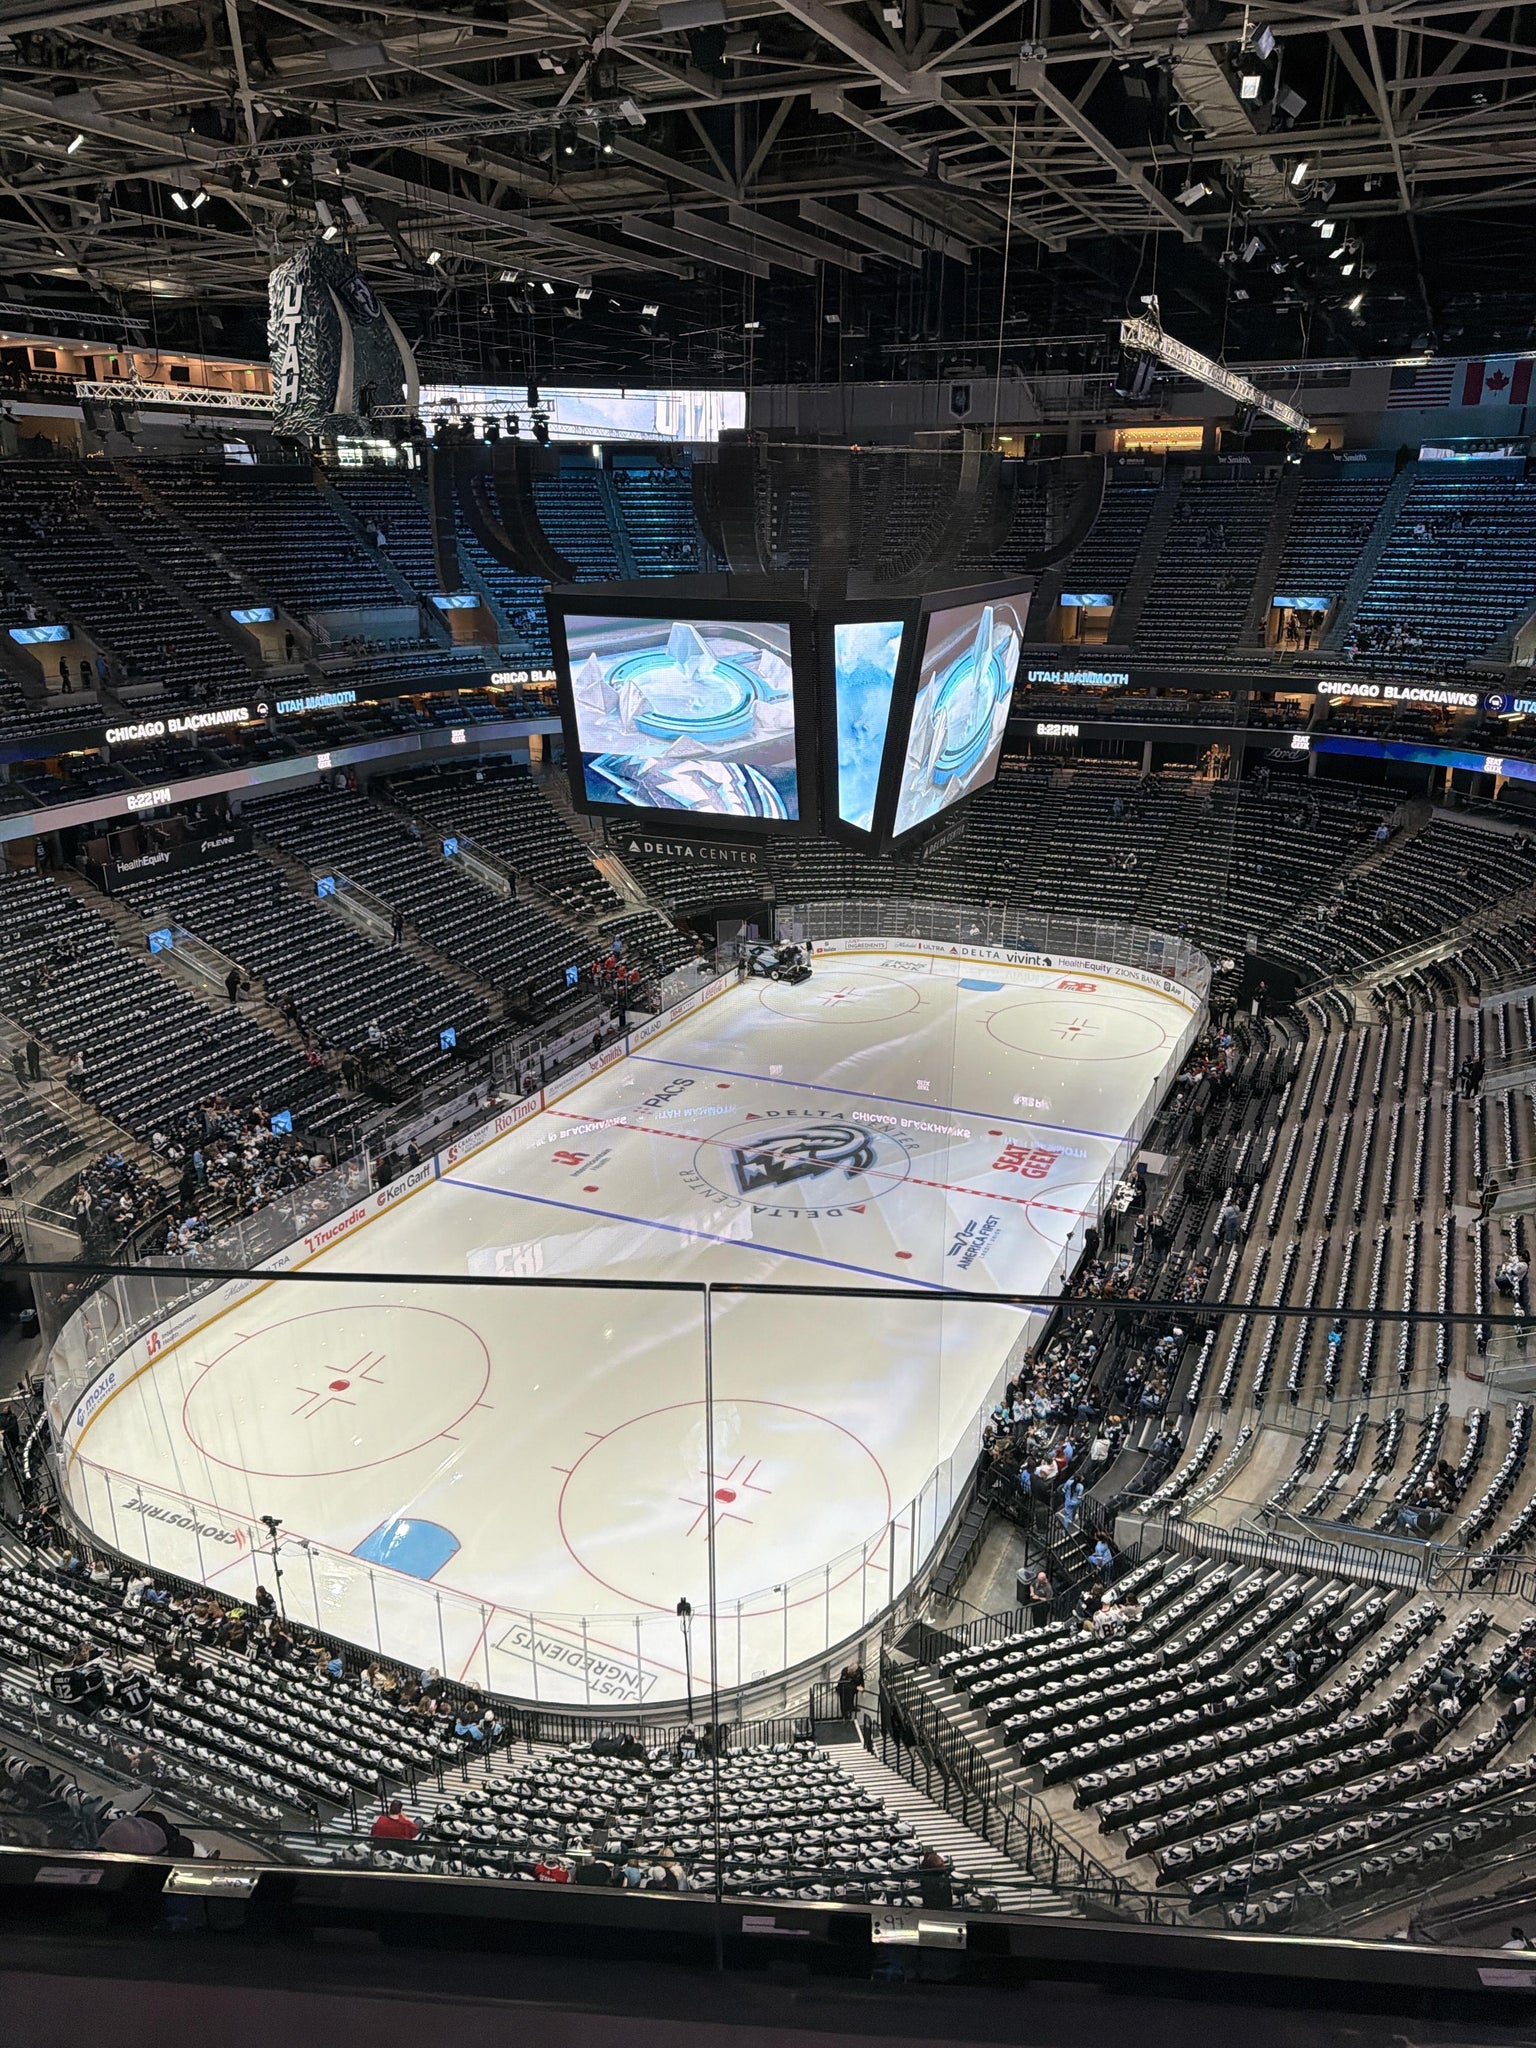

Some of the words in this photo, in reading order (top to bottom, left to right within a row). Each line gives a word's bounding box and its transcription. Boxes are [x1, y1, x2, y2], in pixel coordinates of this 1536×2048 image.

[279, 284, 303, 403] UTAH
[1028, 671, 1060, 683] UTAH
[1063, 672, 1129, 684] MAMMOTH
[276, 699, 304, 714] UTAH
[306, 691, 356, 710] MAMMOTH
[1318, 681, 1379, 697] CHICAGO
[1384, 686, 1478, 706] BLACKHAWKS
[106, 721, 165, 743] CHICAGO
[168, 708, 249, 733] BLACKHAWKS
[1061, 725, 1079, 737] PM
[1486, 757, 1503, 766] SEAT
[127, 790, 152, 810] 6:22
[152, 787, 171, 805] PM
[117, 852, 171, 873] HealthEquity
[644, 842, 694, 857] DELTA
[699, 847, 758, 864] CENTER
[923, 943, 945, 952] ULTRA
[962, 947, 1000, 959] DELTA
[1006, 953, 1041, 966] vivint
[1058, 957, 1112, 975] HealthEquity
[1115, 967, 1140, 981] ZIONS
[1141, 973, 1161, 988] BANK
[642, 1078, 696, 1108] PACS
[767, 1109, 845, 1119] DELTA
[992, 1143, 1032, 1173] SEAT
[387, 1181, 407, 1202] Ken
[406, 1164, 431, 1188] Garff
[679, 1169, 742, 1209] CENTER
[752, 1205, 843, 1219] DELTA
[314, 1208, 366, 1246] Trucordia
[957, 1236, 988, 1270] AMERICA
[979, 1215, 1000, 1237] FIRST
[85, 1372, 116, 1411] moxie
[122, 1498, 238, 1545] CROWDSTRIKE
[512, 1632, 644, 1689] INGREDIENTS
[589, 1678, 637, 1701] JUST
